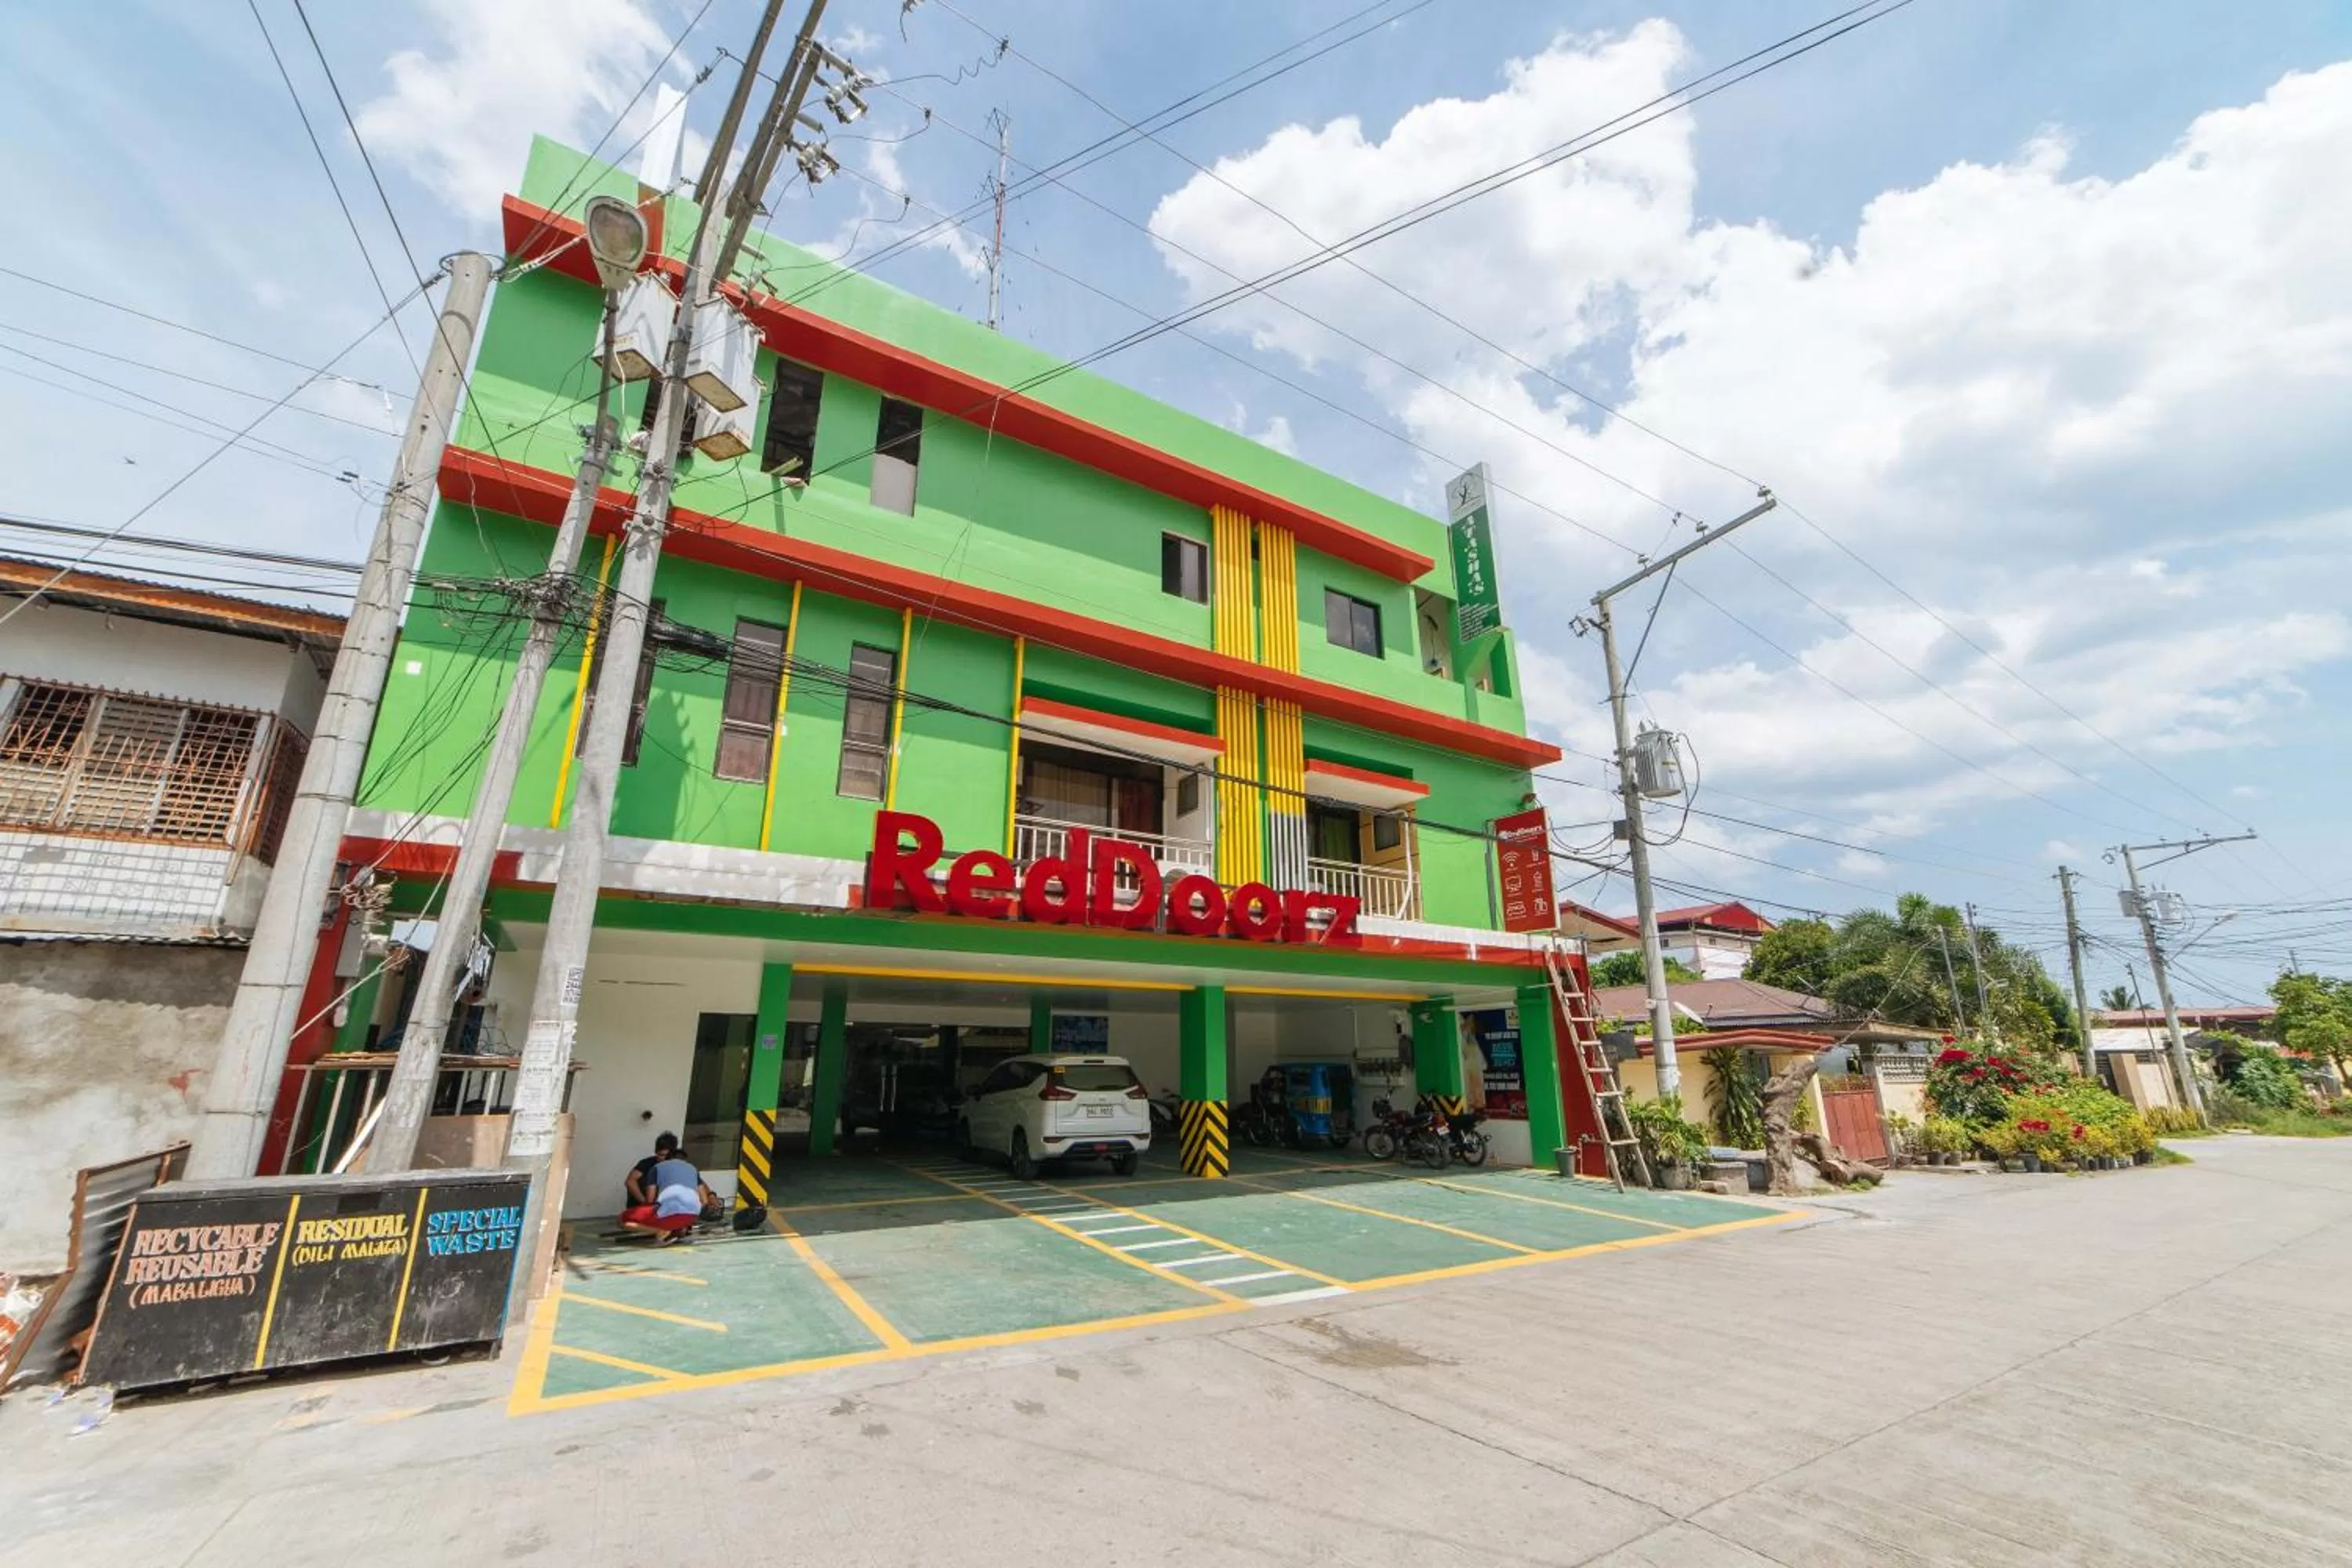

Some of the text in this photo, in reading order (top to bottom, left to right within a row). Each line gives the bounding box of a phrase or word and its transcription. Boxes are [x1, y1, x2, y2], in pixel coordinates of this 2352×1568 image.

[868, 810, 1363, 946] RedDoorz
[296, 1214, 409, 1243] RESIDUAL
[427, 1207, 521, 1234] SPECIAL
[131, 1221, 283, 1257] RECYCABLE
[426, 1229, 516, 1256] WASTE
[124, 1247, 267, 1285] REUSABLE
